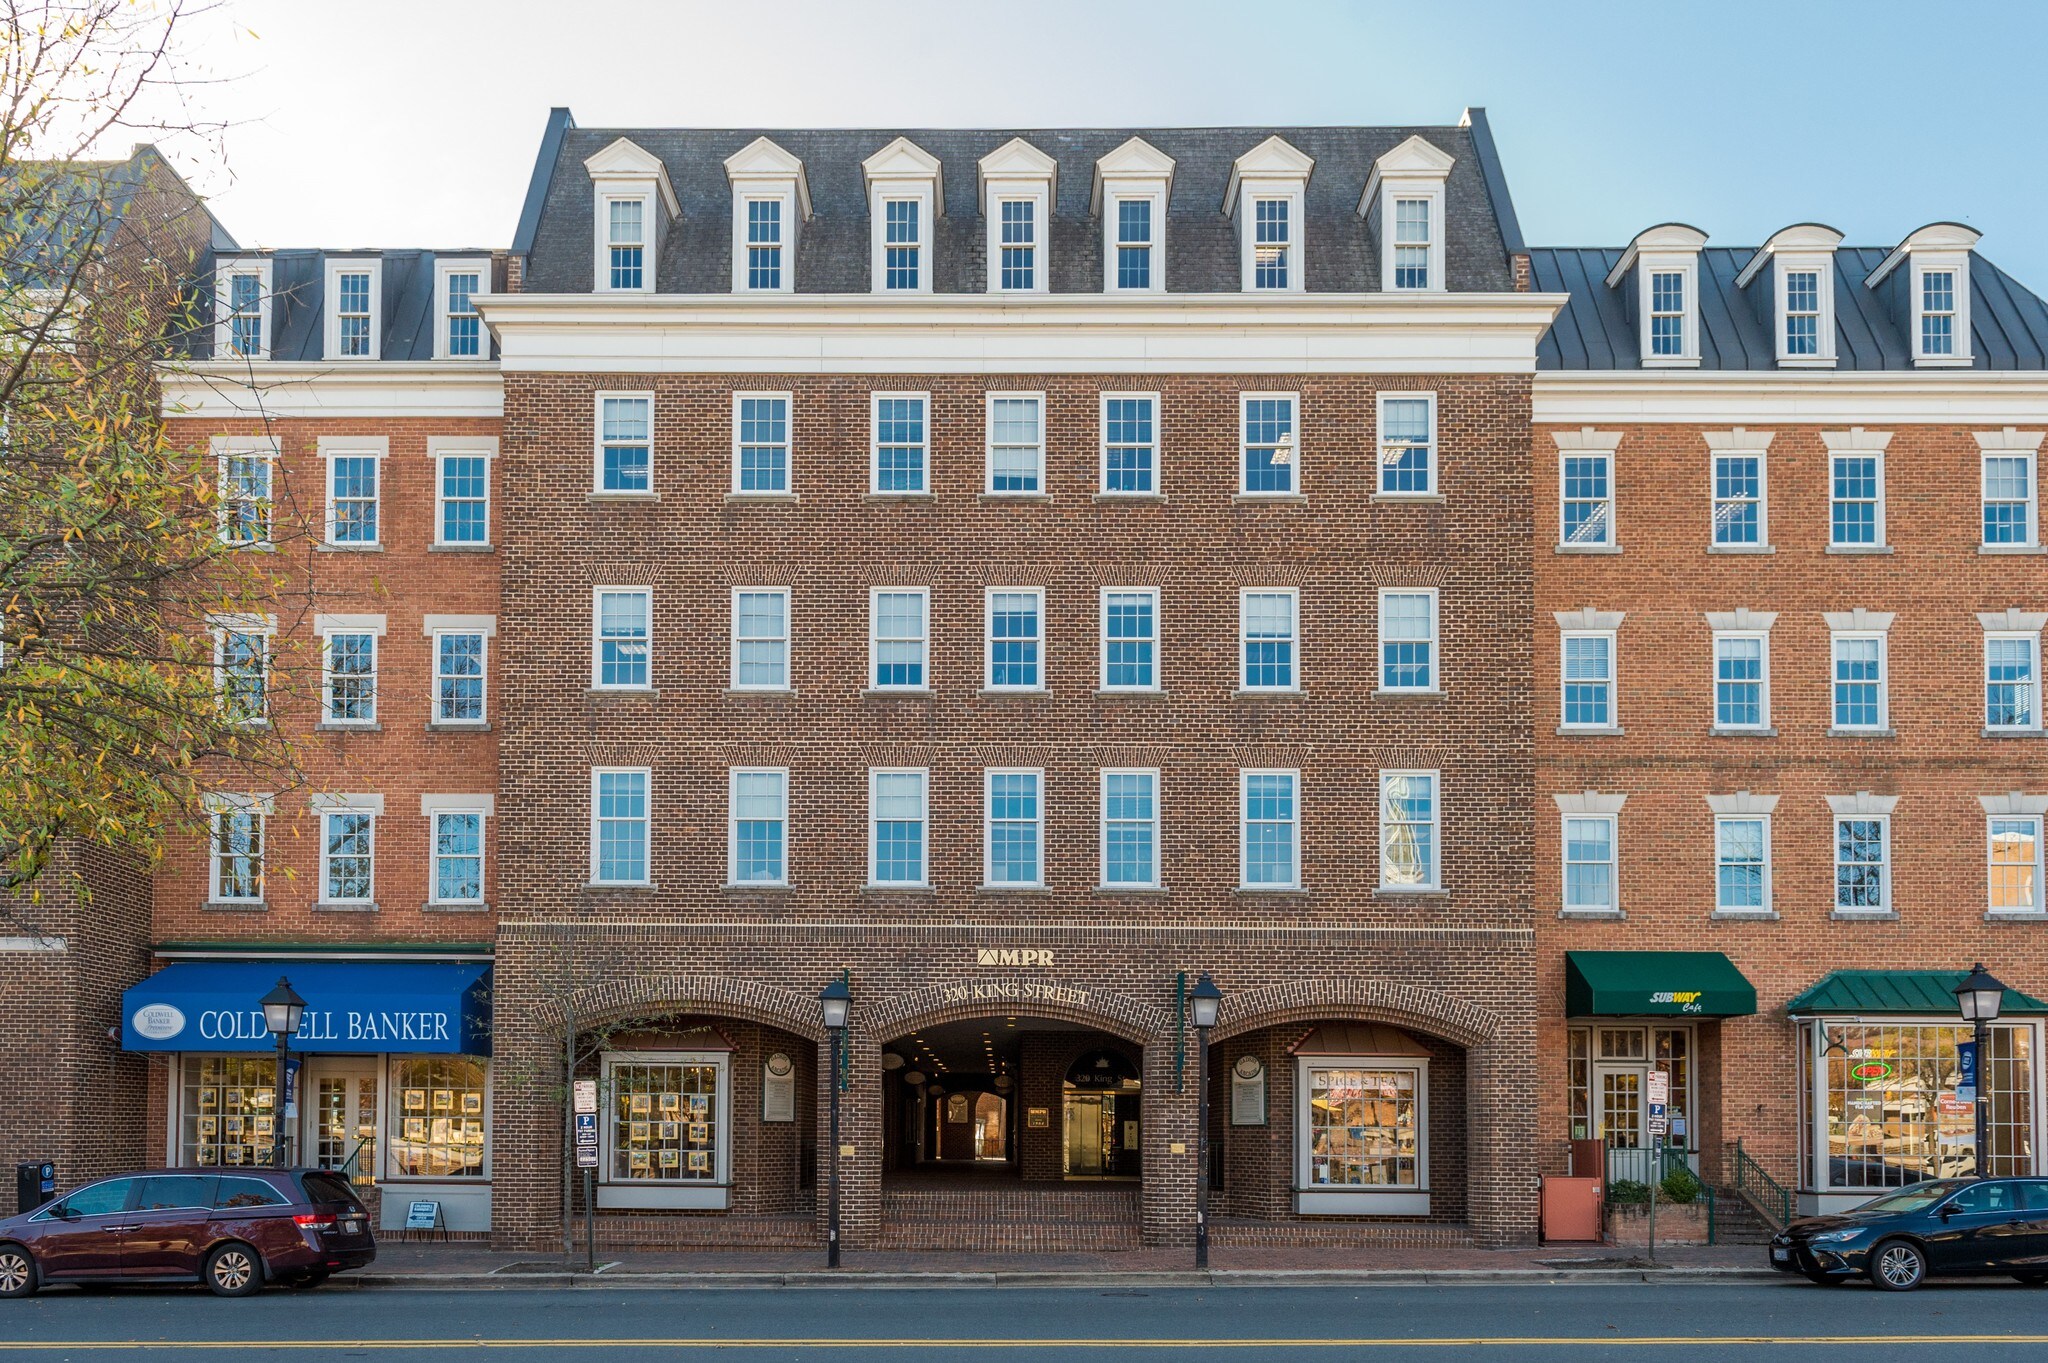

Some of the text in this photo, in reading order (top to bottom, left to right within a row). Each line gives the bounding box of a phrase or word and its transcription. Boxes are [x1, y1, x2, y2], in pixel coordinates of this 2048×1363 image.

[999, 949, 1055, 966] MPR
[943, 983, 1090, 1005] 320 KING STREET
[1649, 991, 1702, 1003] SUBWAY
[200, 1010, 450, 1040] COLDELL BANKER
[1370, 1076, 1398, 1086] TEA
[1654, 1105, 1661, 1114] P
[583, 1116, 590, 1125] P
